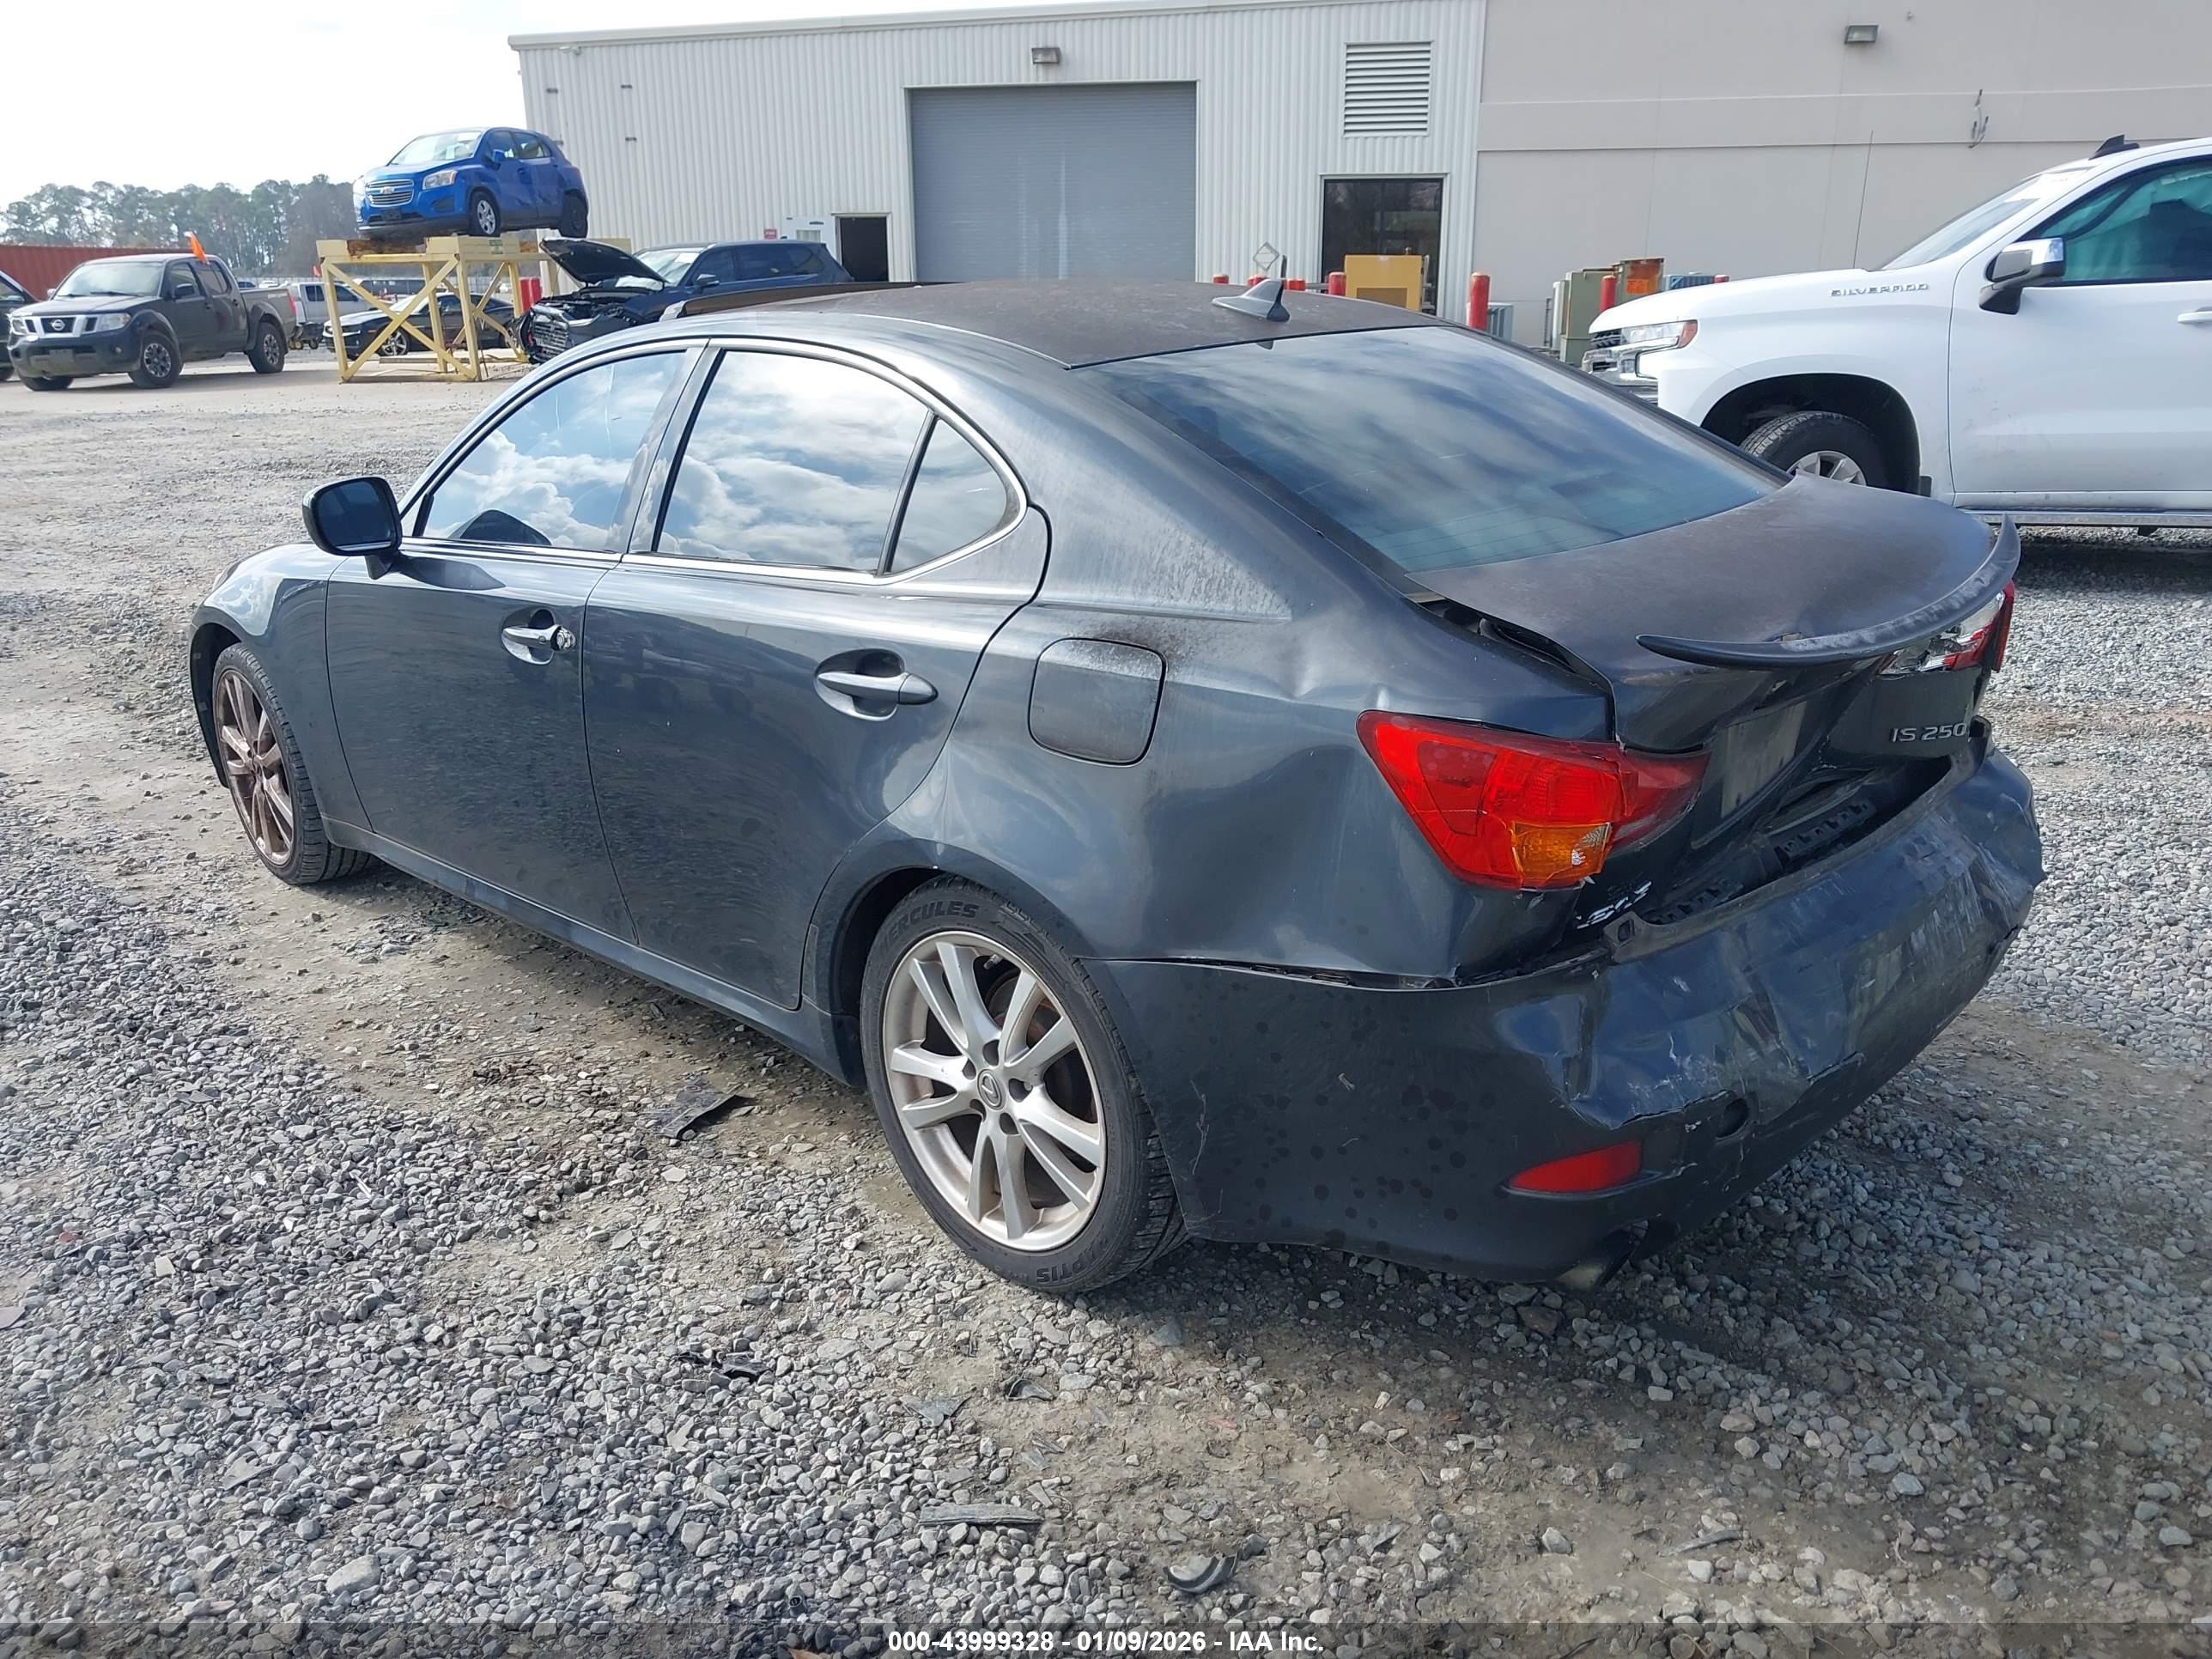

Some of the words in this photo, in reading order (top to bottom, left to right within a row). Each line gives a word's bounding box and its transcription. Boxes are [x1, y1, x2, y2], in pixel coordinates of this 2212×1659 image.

[1830, 283, 1929, 297] SILVERADO
[1891, 727, 1917, 742] IS
[1921, 722, 1967, 740] 250
